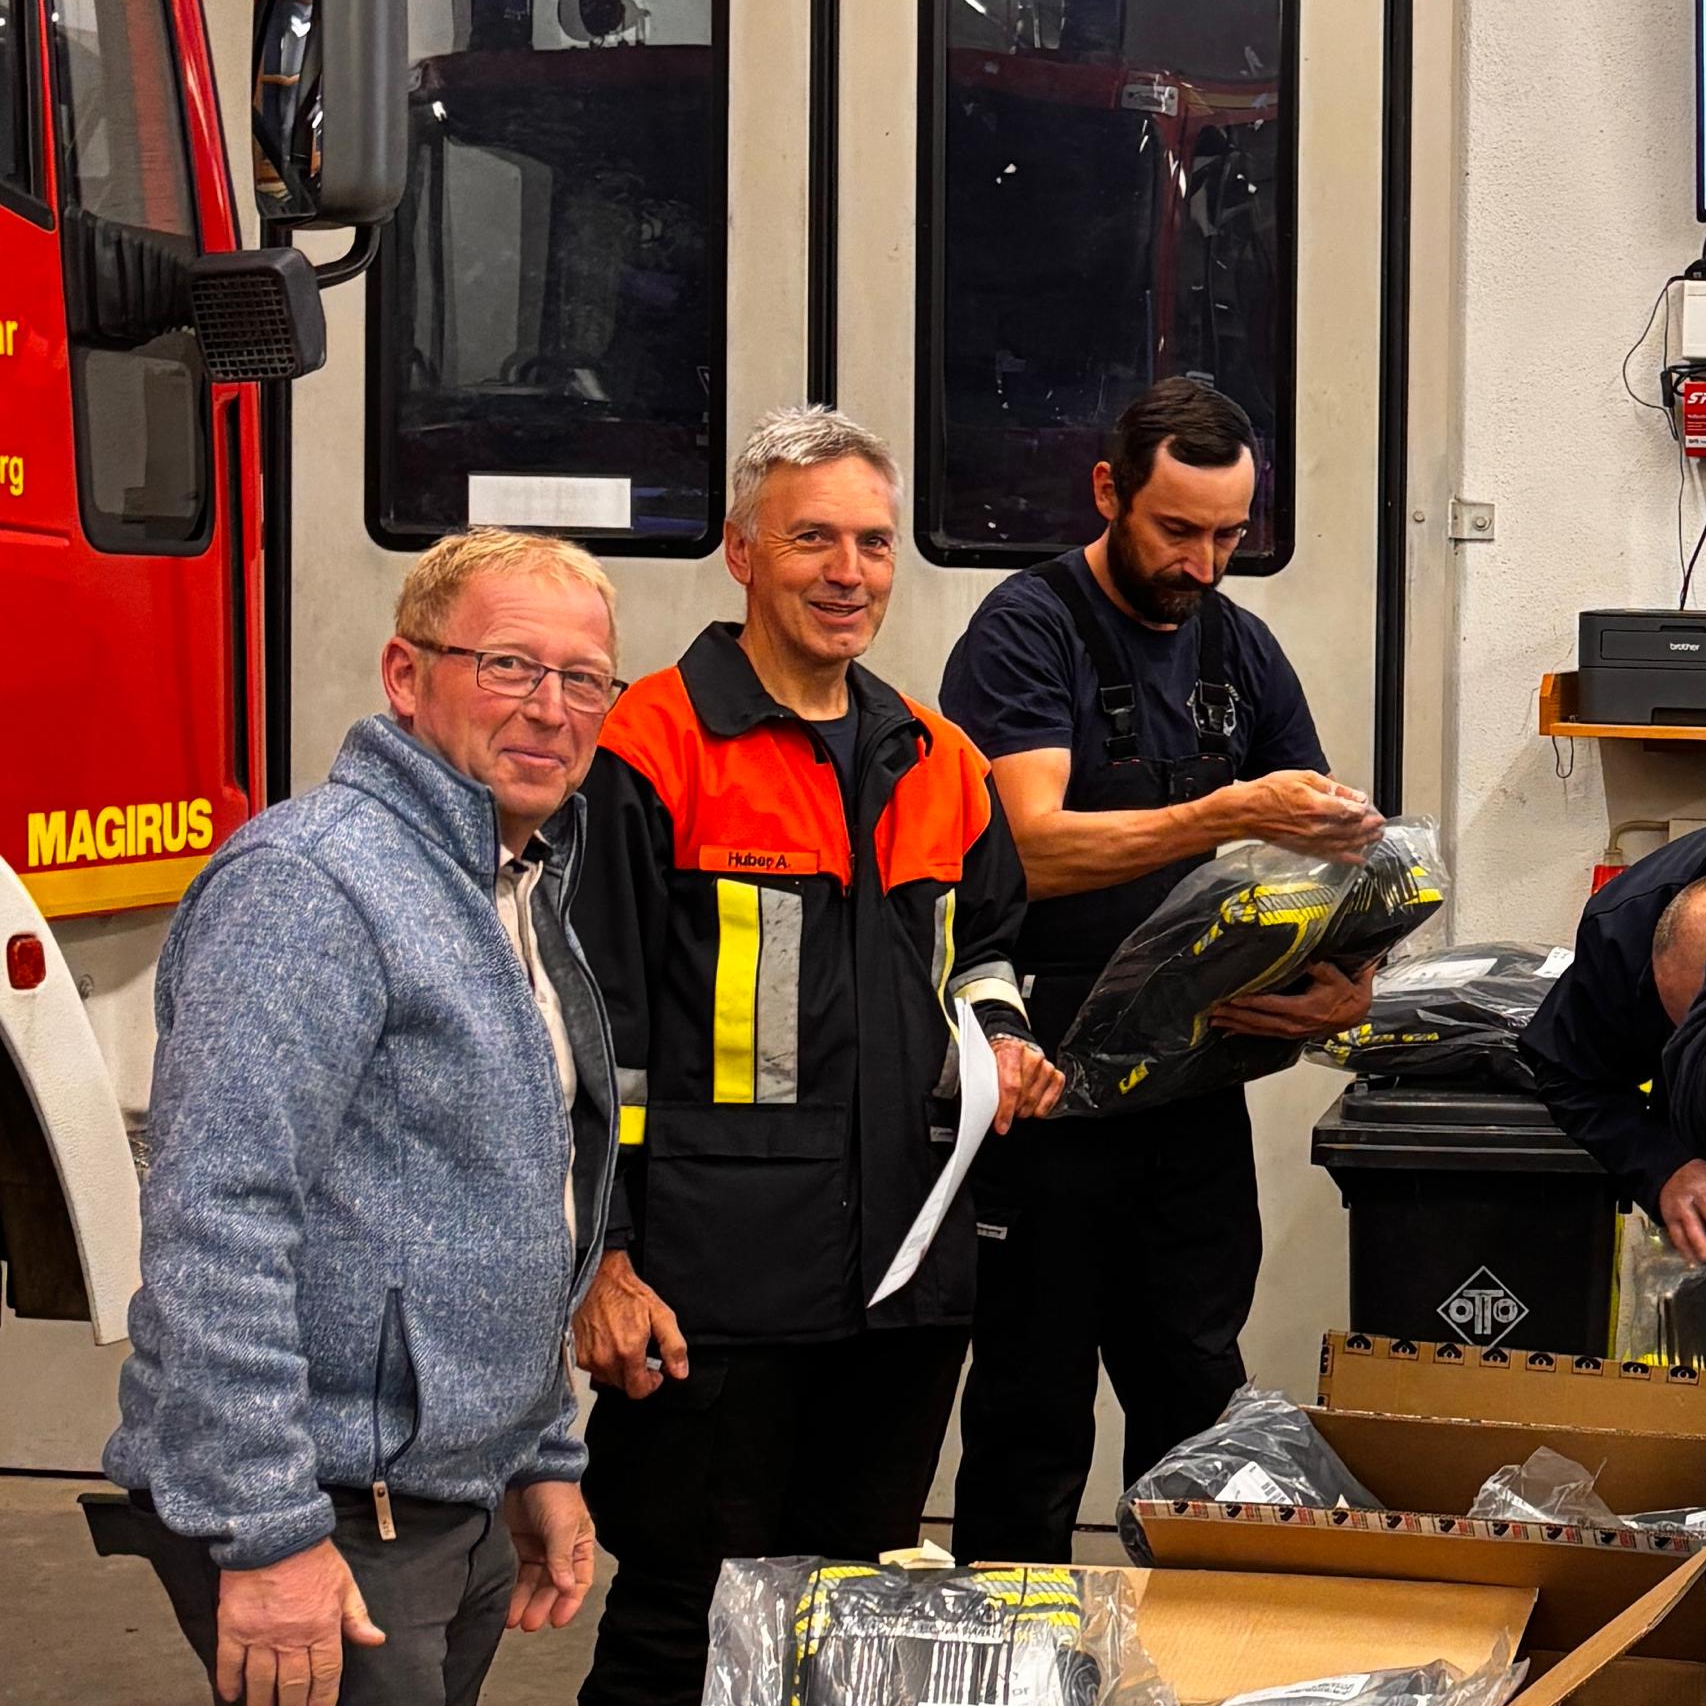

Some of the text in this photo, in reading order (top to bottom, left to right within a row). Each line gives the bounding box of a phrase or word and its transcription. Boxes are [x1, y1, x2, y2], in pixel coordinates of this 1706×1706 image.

[1669, 642, 1701, 652] brother
[27, 798, 213, 868] MAGIRUS
[1448, 1289, 1518, 1335] OTTO
